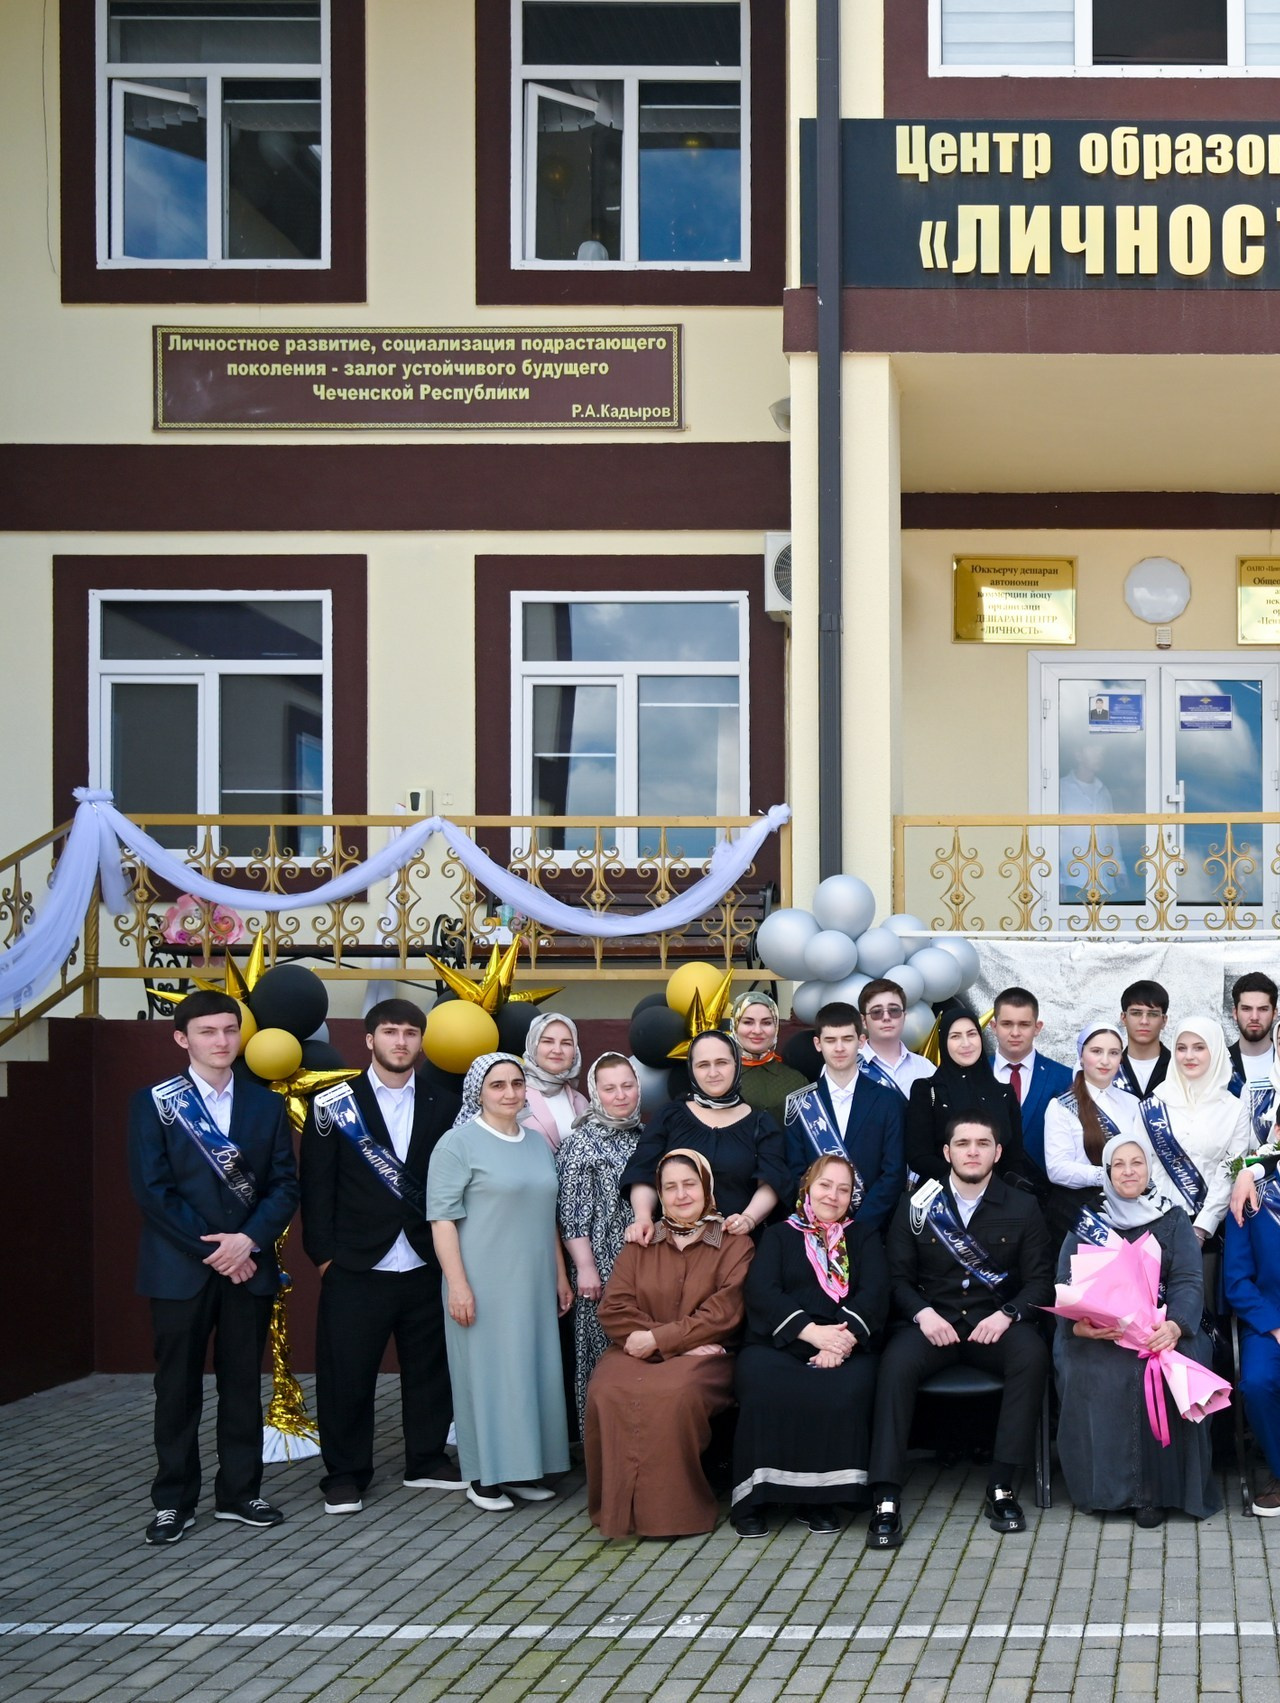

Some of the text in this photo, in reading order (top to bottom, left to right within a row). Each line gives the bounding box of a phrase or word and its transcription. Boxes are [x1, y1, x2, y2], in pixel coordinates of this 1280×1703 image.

[896, 126, 1051, 182] Центр
[167, 335, 667, 355] Личностное развитие, социализация подрастающего
[227, 363, 326, 376] поколения
[344, 363, 396, 376] залог
[402, 359, 516, 380] устойчивого
[522, 359, 610, 380] будущего
[312, 383, 530, 405] Чеченской Республики
[571, 403, 672, 420] Р.А.Кадыров
[1020, 567, 1058, 577] дешаран
[1148, 1118, 1200, 1196] Выпускница
